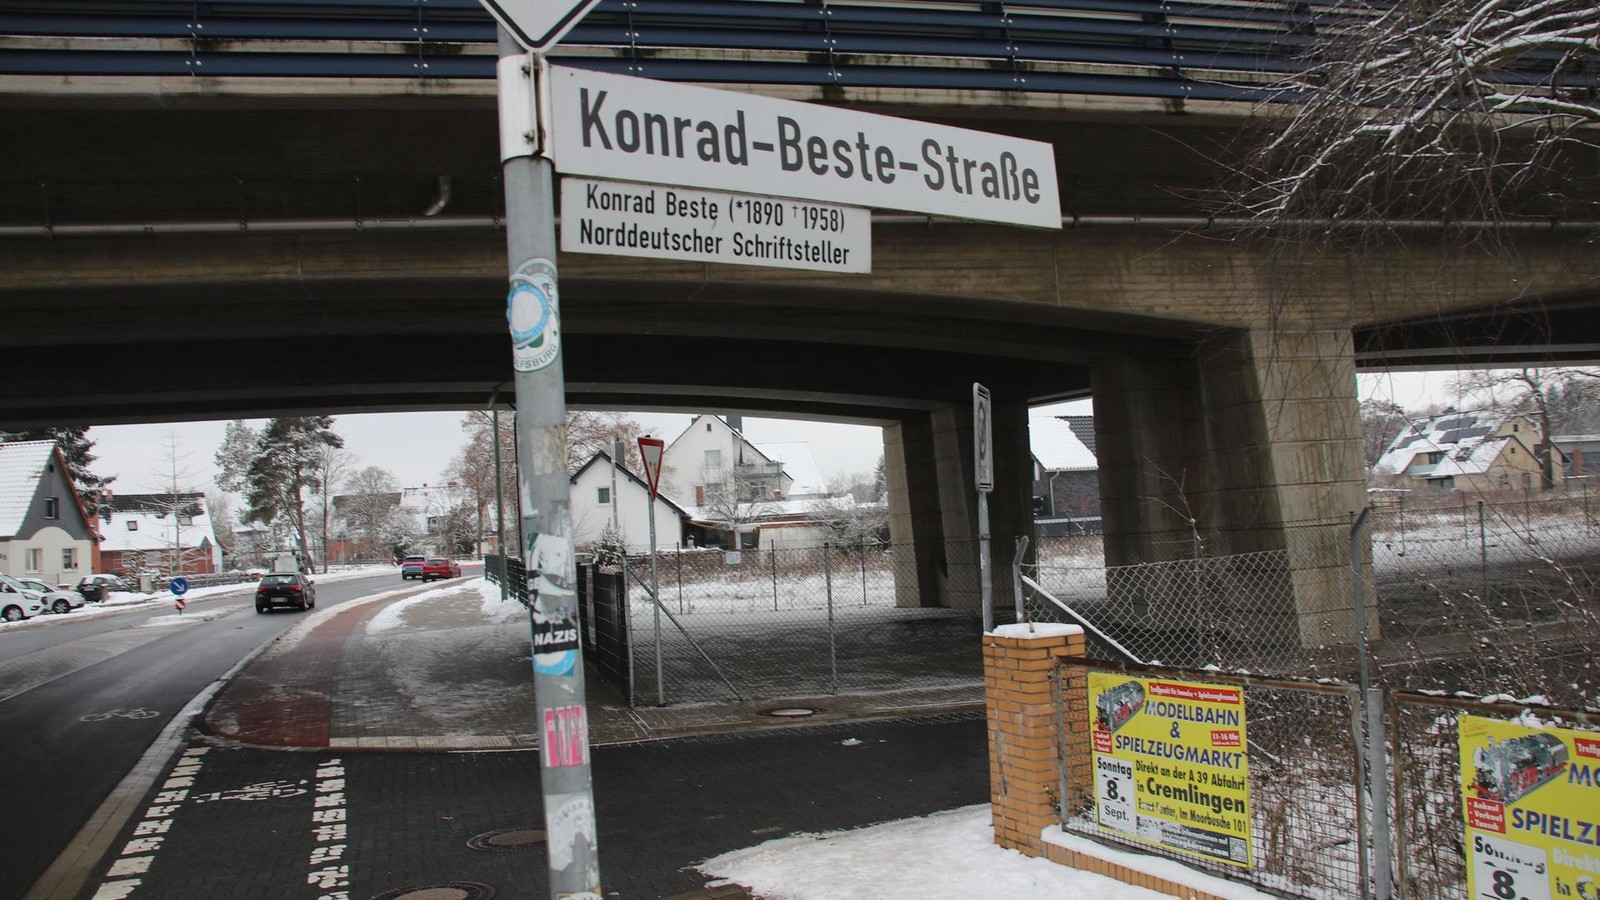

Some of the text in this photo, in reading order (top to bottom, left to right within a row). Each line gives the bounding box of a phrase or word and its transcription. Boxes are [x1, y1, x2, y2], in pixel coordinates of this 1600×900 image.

[580, 87, 1041, 204] Konrad-Beste-Straße
[586, 183, 655, 215] Konrad
[666, 191, 719, 221] Beste
[580, 218, 850, 265] Norddeutscher Schriftsteller
[534, 628, 577, 647] NAZIS
[1144, 700, 1239, 727] MODELLBAHN
[1170, 721, 1180, 739] &
[1115, 734, 1242, 770] SPIELZEUGMARKT
[1097, 756, 1132, 780] Sonntag
[1136, 759, 1245, 791] Direkt an der A 39 Abfahrt
[1107, 779, 1126, 803] 8.
[1137, 780, 1144, 793] in
[1146, 777, 1246, 814] Cremlingen
[1104, 805, 1130, 821] Sept.
[1190, 809, 1231, 830] Moorbusche
[1233, 818, 1247, 833] 101
